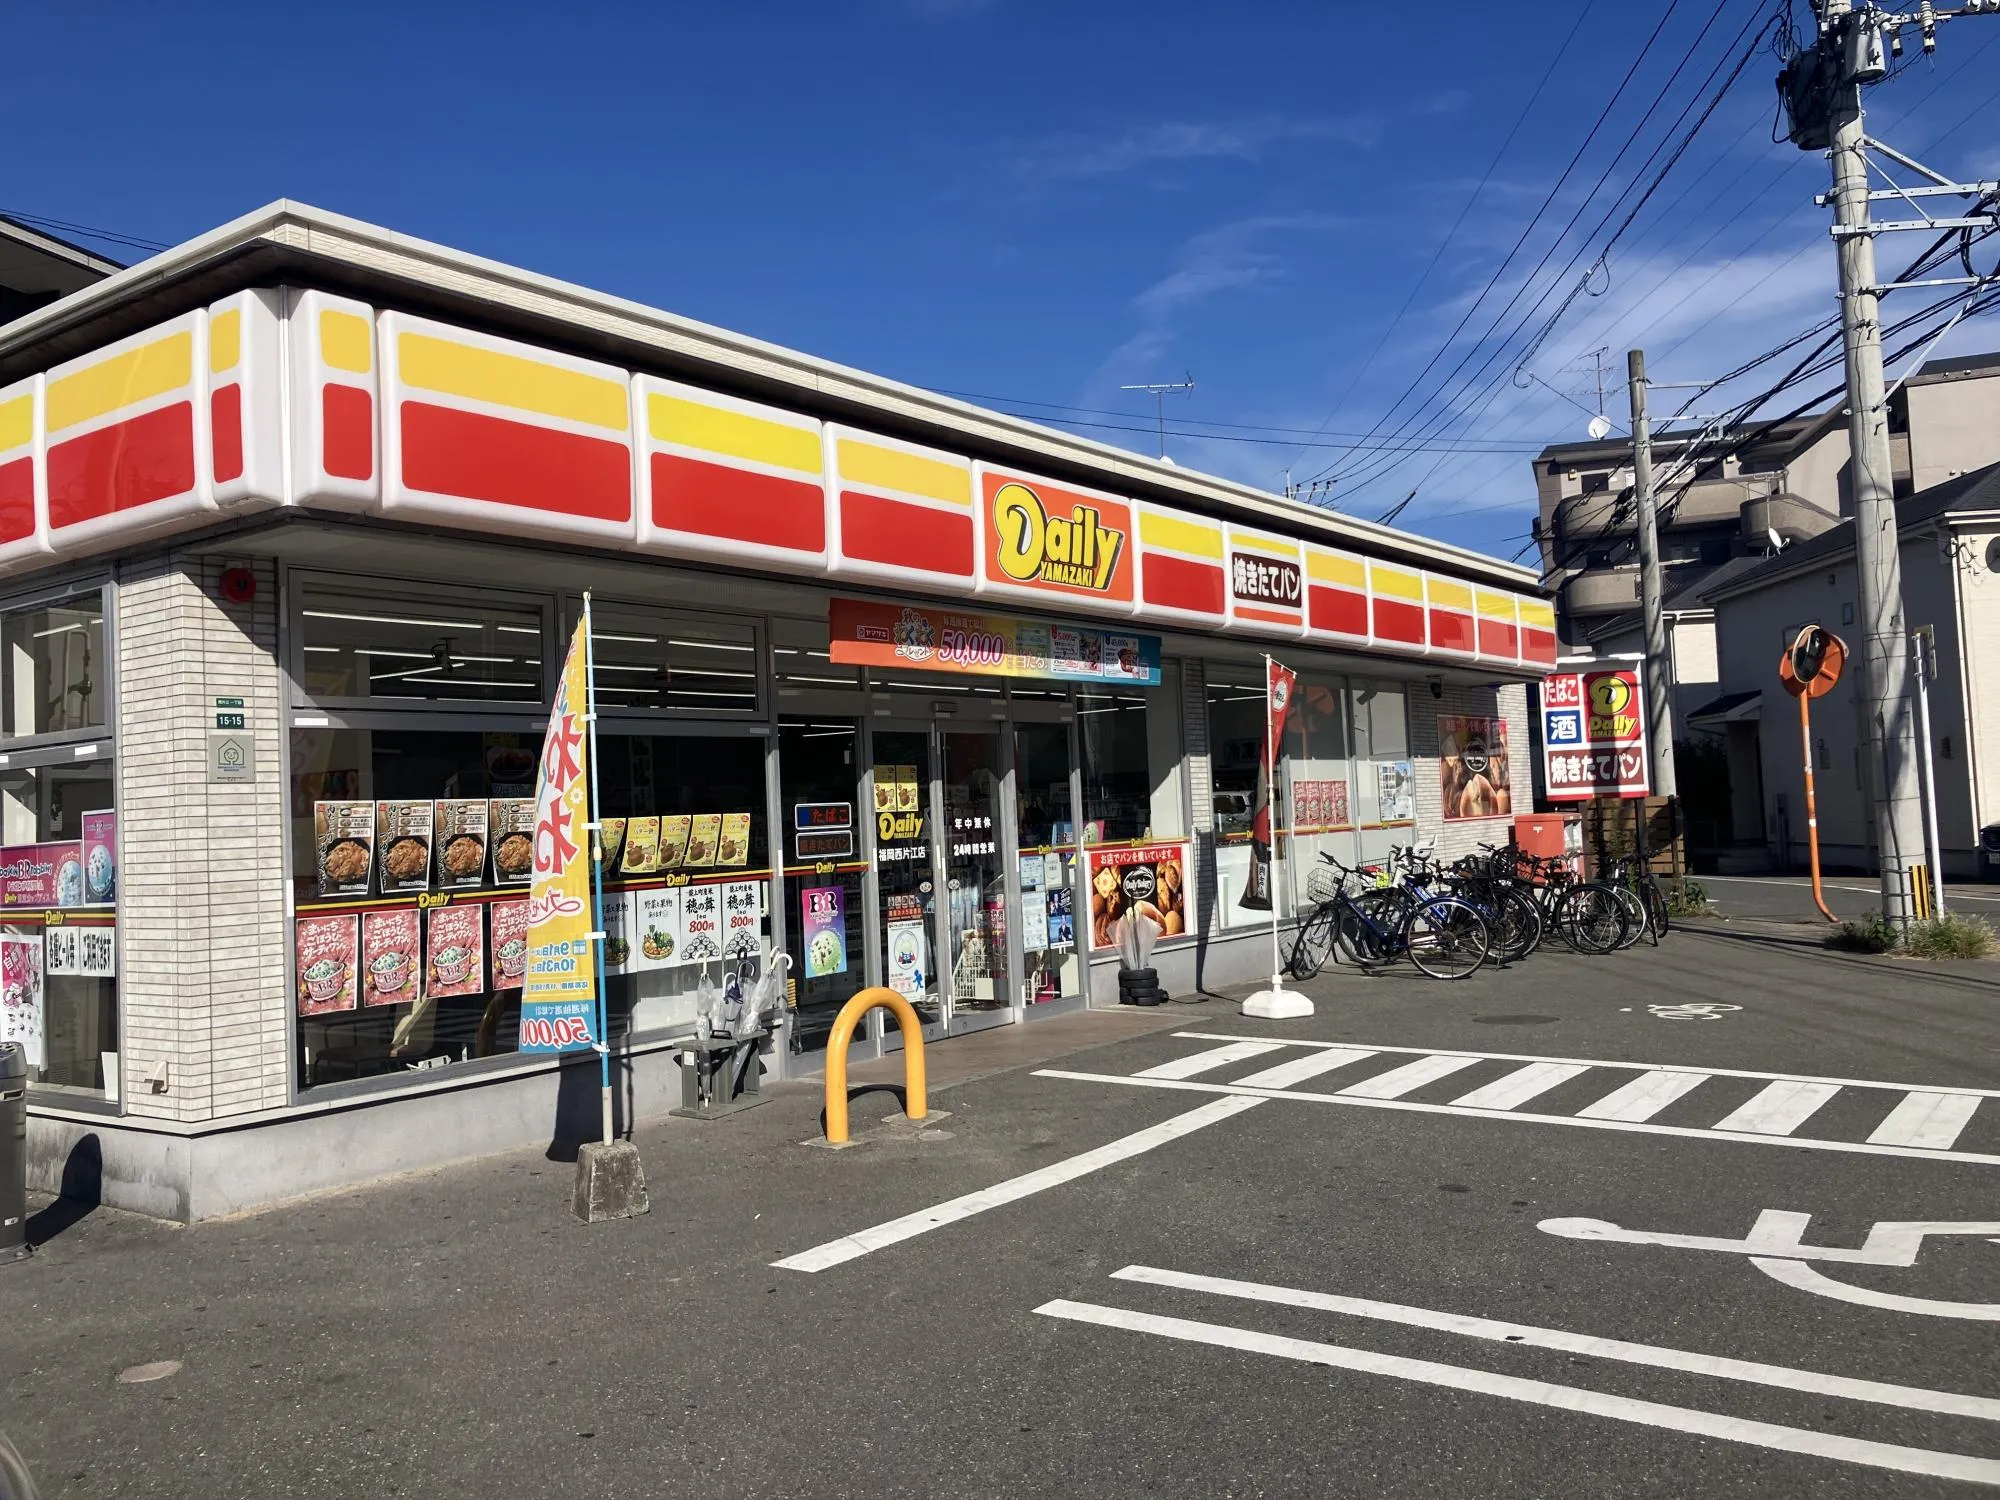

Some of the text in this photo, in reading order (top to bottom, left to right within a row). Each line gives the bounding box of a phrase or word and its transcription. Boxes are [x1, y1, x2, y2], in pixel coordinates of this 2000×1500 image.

[993, 483, 1124, 590] Daily
[1040, 560, 1093, 587] YAMAZAKI
[1233, 557, 1300, 600] 焼きたてパン
[939, 629, 1004, 667] 50,000
[1544, 678, 1578, 704] たばこ
[220, 716, 242, 725] 15-15
[1550, 715, 1577, 740] 酒
[1590, 715, 1637, 737] Daily
[1551, 753, 1641, 783] 焼きたてパン
[810, 806, 848, 824] たばこ
[954, 816, 991, 830] 年中無休
[879, 812, 923, 840] Daily
[879, 846, 926, 862] 福岡西片江店
[953, 842, 996, 856] 24時間営業
[1101, 849, 1174, 865] お店でパンを焼いています。
[816, 861, 835, 874] Daily
[666, 874, 690, 887] Daily
[418, 892, 450, 908] Daily
[644, 899, 673, 910] 野菜と果物
[686, 896, 715, 914] 穂の舞
[727, 892, 755, 910] 穂の舞
[809, 892, 837, 913] BR
[45, 910, 65, 925] Daily
[373, 915, 403, 928] まいにち
[438, 911, 466, 923] まいにち
[731, 915, 754, 928] 800円
[307, 921, 339, 936] まいにち
[374, 926, 406, 940] ごほうび
[438, 921, 469, 934] ごほうび
[689, 921, 715, 933] 800円
[307, 932, 342, 947] ごほうび
